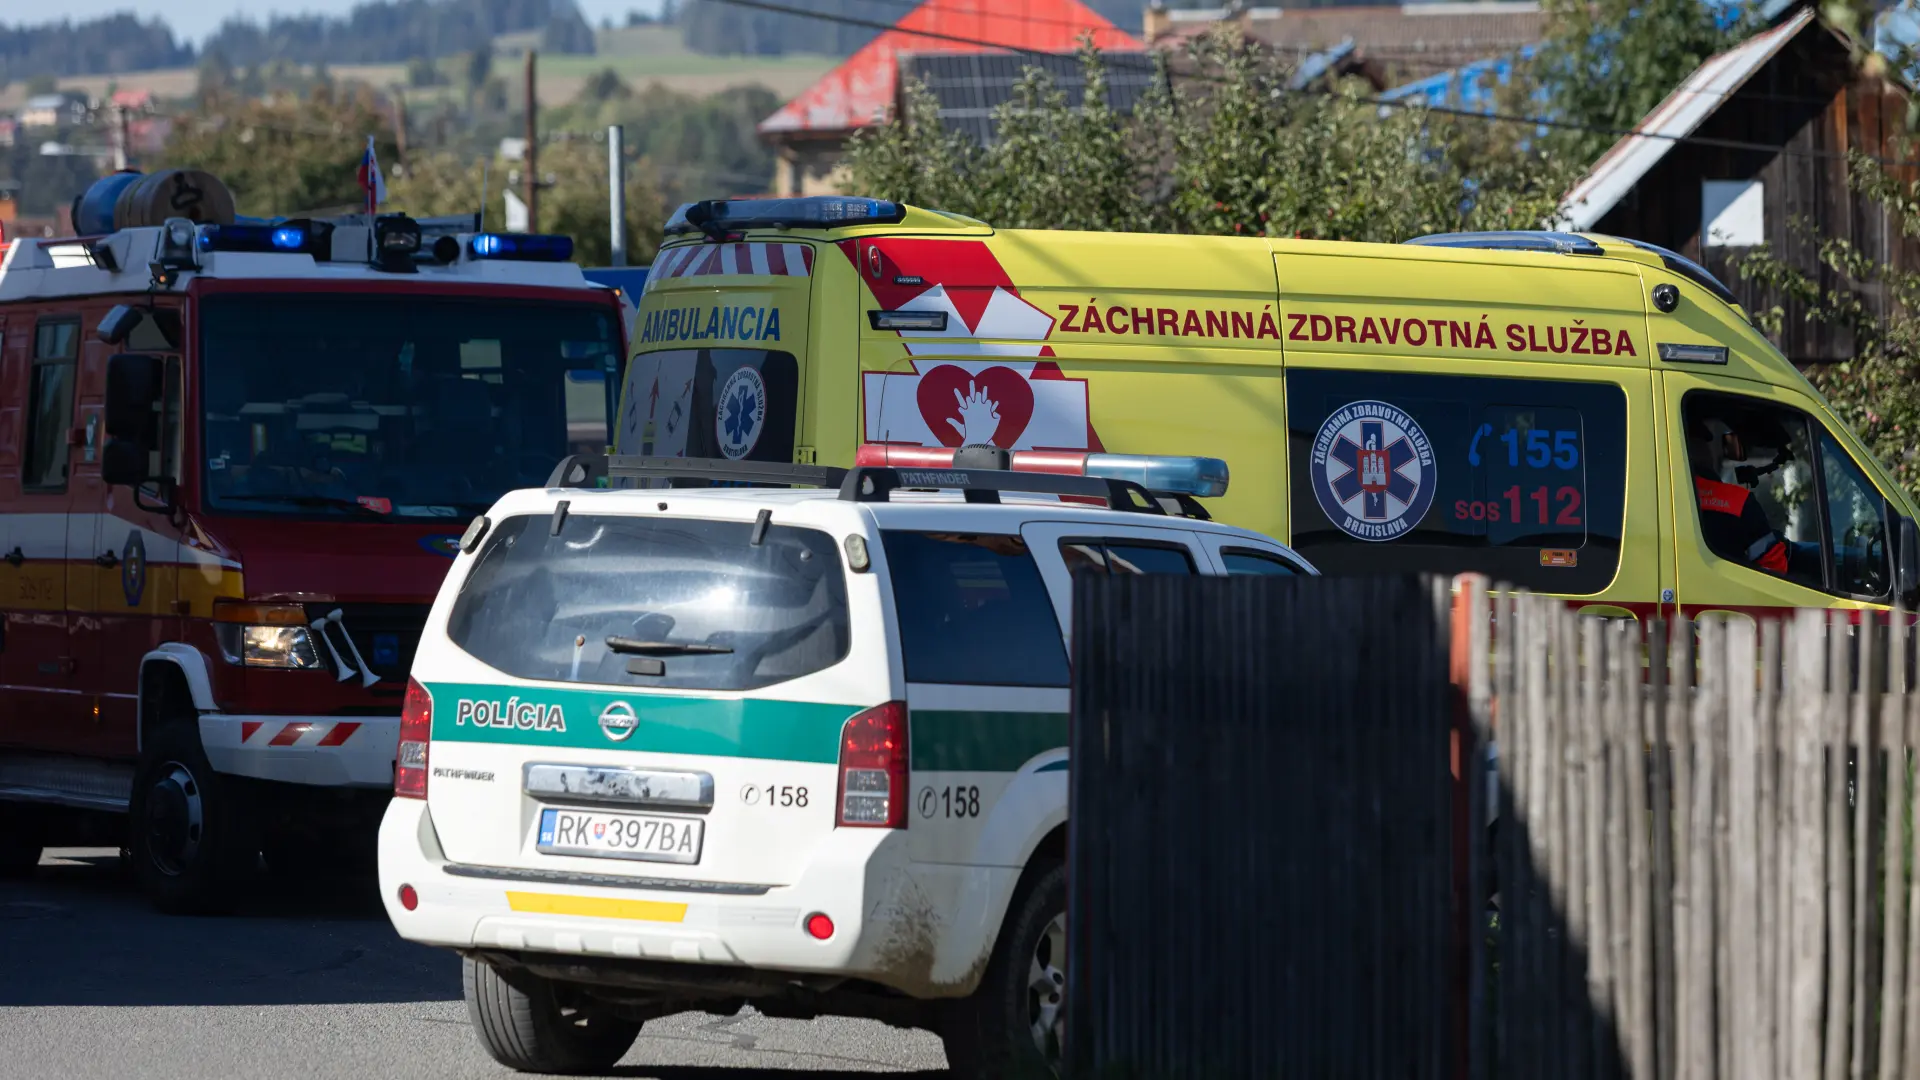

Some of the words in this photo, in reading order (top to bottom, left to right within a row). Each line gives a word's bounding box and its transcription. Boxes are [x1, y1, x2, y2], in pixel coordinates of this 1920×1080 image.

[641, 306, 780, 343] AMBULANCIA
[1058, 298, 1280, 340] ZÁCHRANNÁ
[1288, 313, 1498, 350] ZDRAVOTNÁ
[1505, 319, 1637, 357] SLUŽBA
[1314, 408, 1353, 465] ZÁCHRANNÁ
[1352, 404, 1410, 430] ZDRAVOTNÁ
[1407, 425, 1432, 467] SLUŽBA
[1501, 428, 1579, 470] 155
[901, 472, 971, 485] PATHFINDER
[1503, 485, 1581, 525] 112
[1343, 516, 1409, 537] BRATISLAVA
[456, 697, 566, 732] POLÍCIA
[433, 767, 495, 782] PATHFINDER
[766, 785, 809, 807] 158
[942, 785, 980, 818] 158
[557, 815, 592, 845] RK
[608, 818, 693, 852] 397BA
